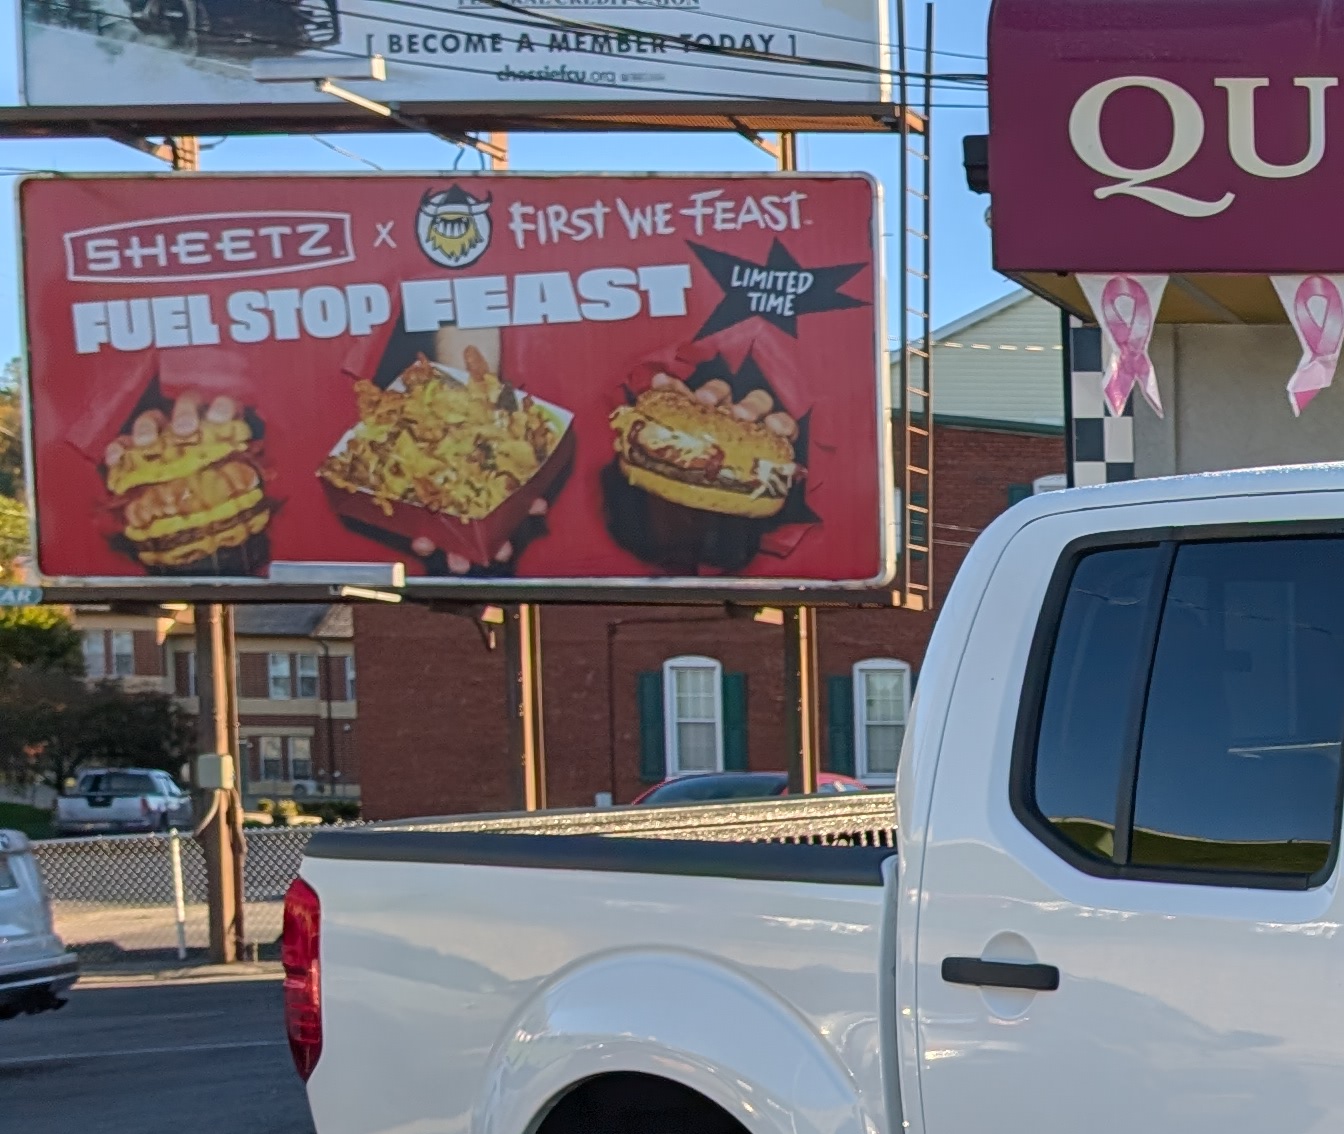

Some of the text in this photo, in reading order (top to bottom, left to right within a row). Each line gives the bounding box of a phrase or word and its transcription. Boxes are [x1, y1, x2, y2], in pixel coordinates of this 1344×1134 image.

[388, 34, 503, 53] BECOME
[516, 33, 534, 53] A
[549, 33, 667, 54] MEMBER
[680, 34, 775, 54] TODAY
[508, 189, 807, 249] FIRST WE FEAST
[85, 223, 332, 272] SHEETZ
[731, 265, 814, 294] LIMITED
[72, 264, 693, 354] FUEL STOP FEAST
[747, 291, 795, 317] TIME
